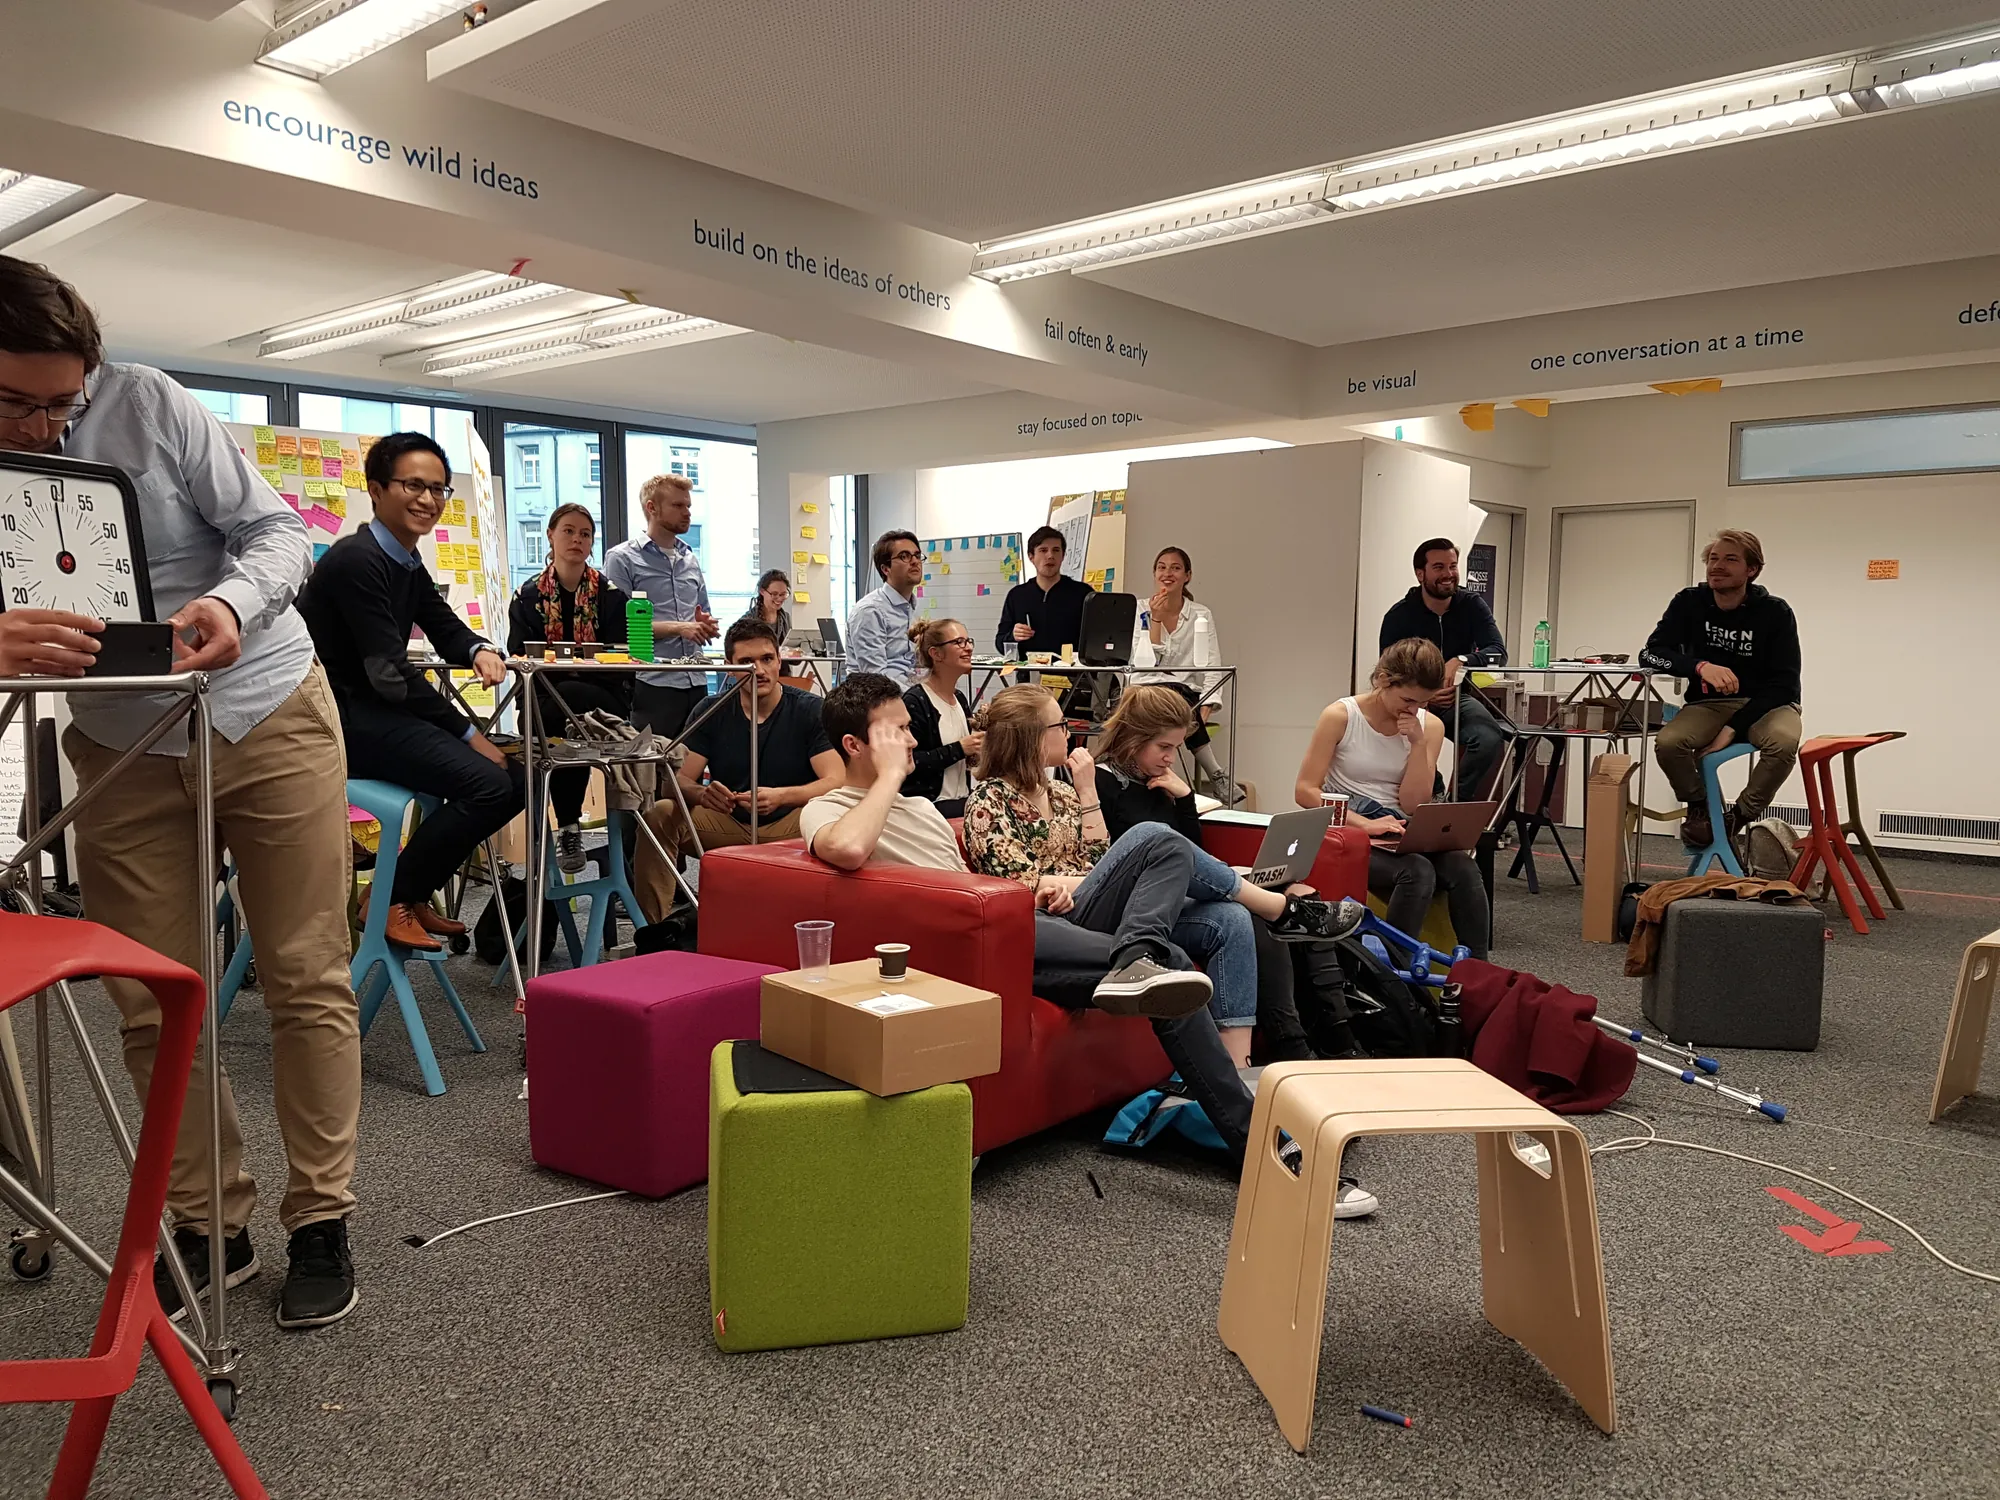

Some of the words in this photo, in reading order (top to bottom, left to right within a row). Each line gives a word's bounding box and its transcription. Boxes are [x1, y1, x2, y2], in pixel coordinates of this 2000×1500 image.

[223, 99, 391, 164] encourage
[402, 146, 461, 180] wild
[472, 158, 539, 200] ideas
[693, 218, 745, 255] build
[752, 242, 778, 265] on
[785, 246, 817, 275] the
[824, 256, 868, 289] ideas
[875, 274, 893, 295] of
[897, 282, 951, 311] others
[1958, 300, 2000, 325] def
[1045, 318, 1063, 341] fail
[1068, 326, 1101, 350] often
[1105, 334, 1115, 354] &
[1119, 342, 1148, 367] early
[1530, 354, 1565, 371] one
[1572, 337, 1700, 366] conversation
[1707, 333, 1728, 352] at
[1735, 334, 1747, 349] a
[1754, 327, 1804, 347] time
[1347, 377, 1367, 394] be
[1372, 369, 1417, 391] visual
[1018, 422, 1039, 437] stay
[1043, 412, 1087, 432] focused
[1091, 414, 1107, 426] on
[23, 490, 33, 508] 5
[77, 494, 93, 512] 55
[1, 514, 16, 532] 10
[102, 522, 118, 540] 50
[0, 551, 15, 569] 15
[115, 558, 130, 575] 45
[12, 587, 29, 604] 20
[1468, 582, 1486, 592] WERTE
[113, 591, 128, 608] 40
[1252, 867, 1286, 885] TRASH
